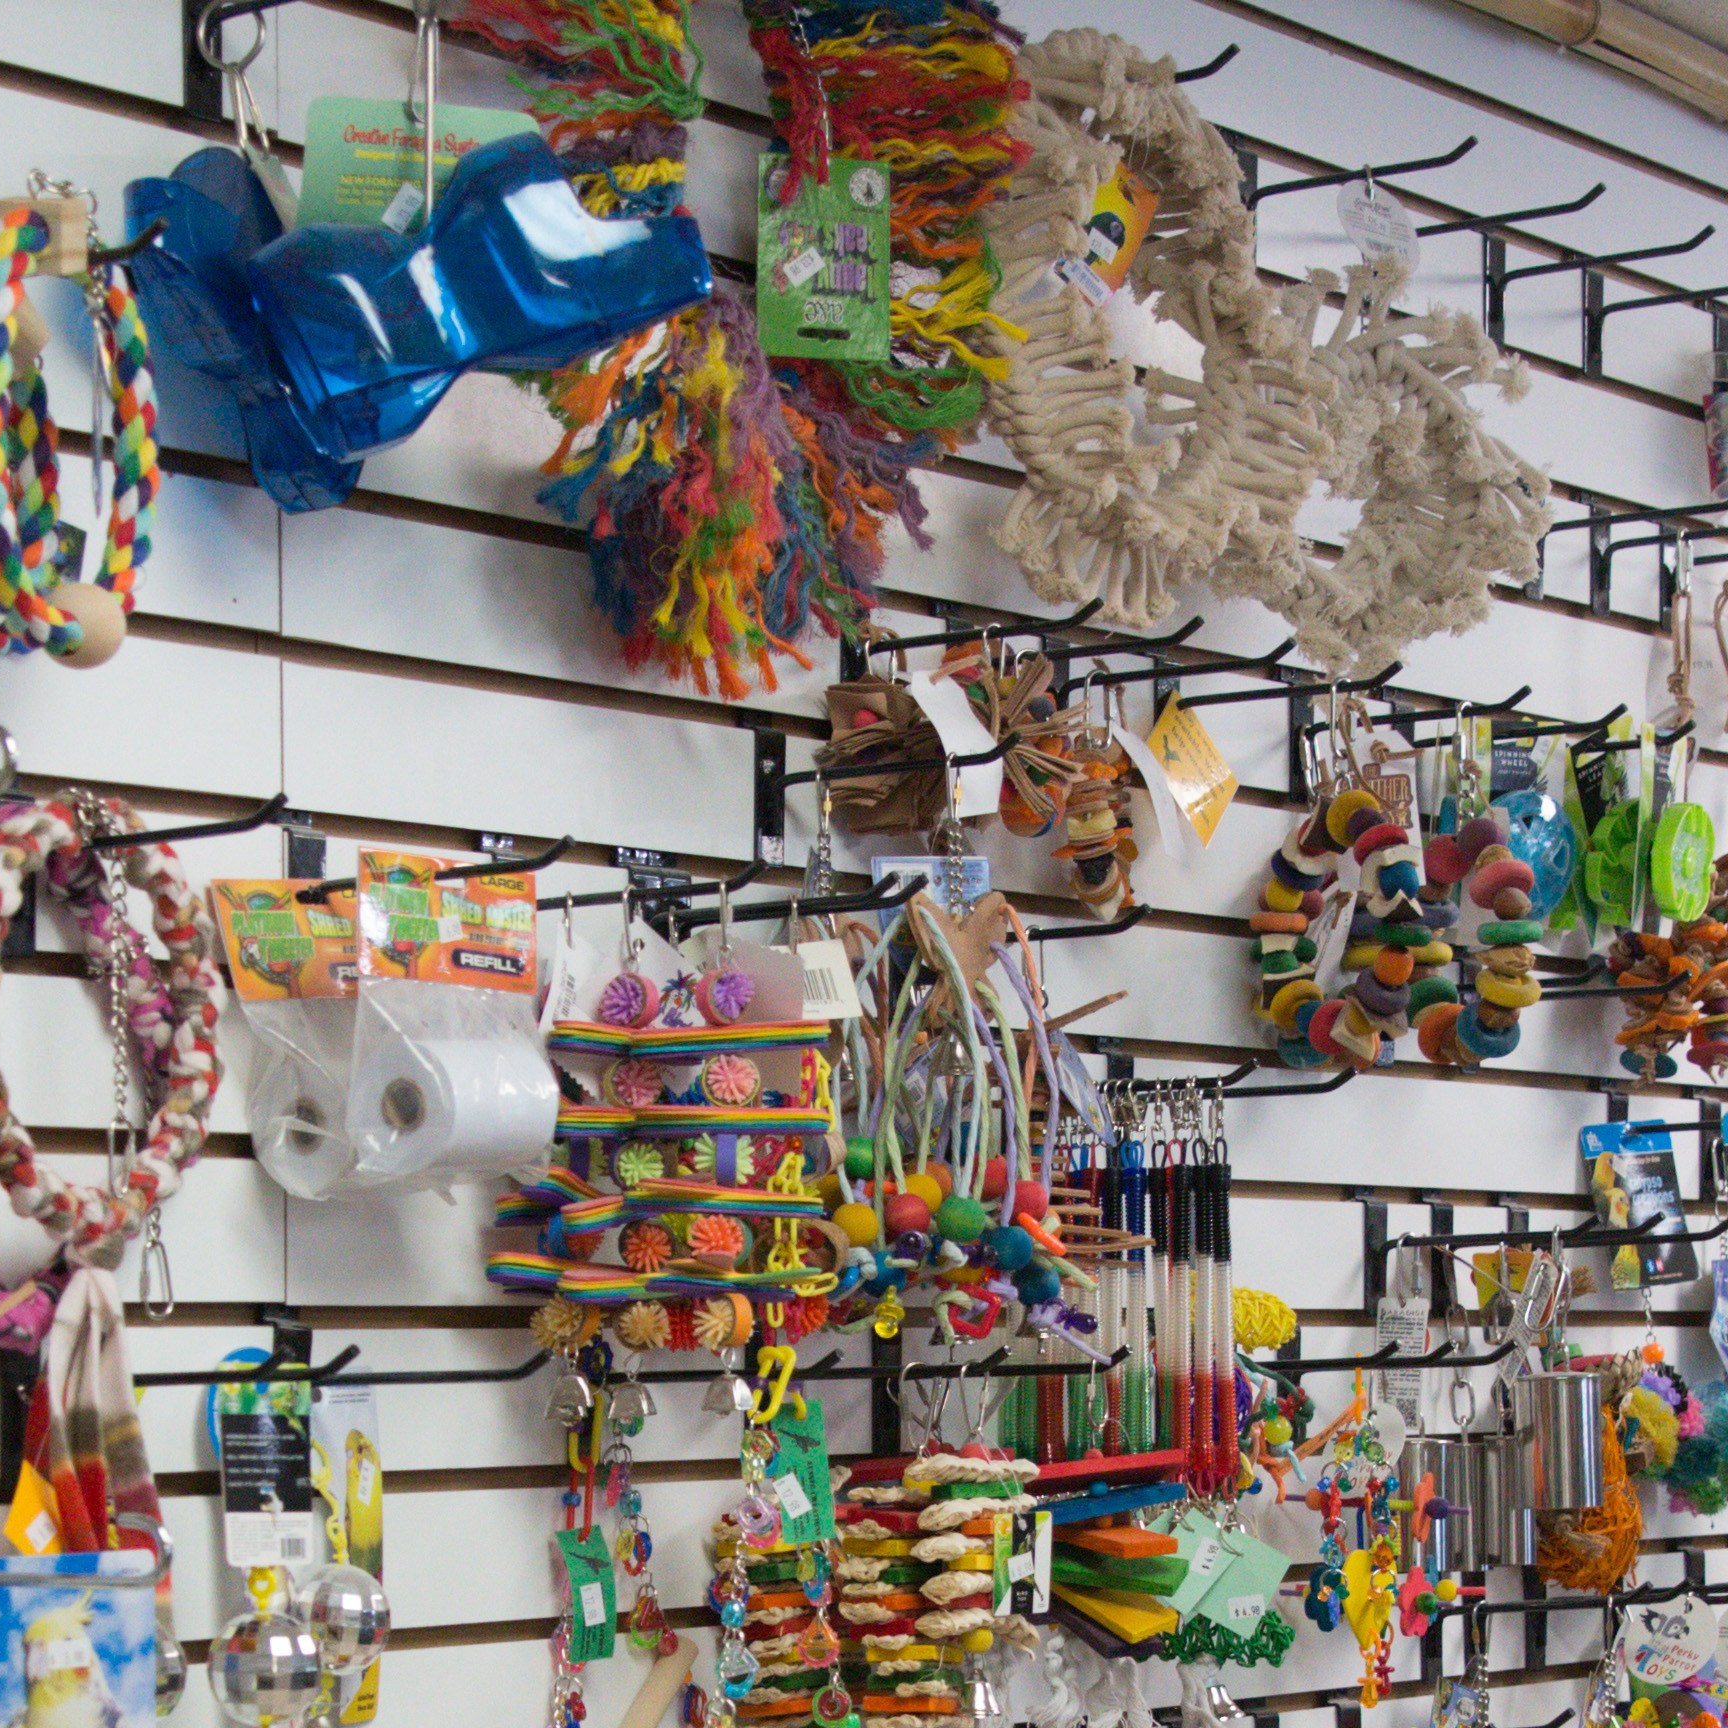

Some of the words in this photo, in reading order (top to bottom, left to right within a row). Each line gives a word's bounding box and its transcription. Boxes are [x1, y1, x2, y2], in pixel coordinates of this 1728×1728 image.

[479, 876, 526, 892] LARGE
[459, 952, 517, 973] REFILL
[1662, 1652, 1697, 1672] Parrot
[1671, 1645, 1700, 1661] Perky
